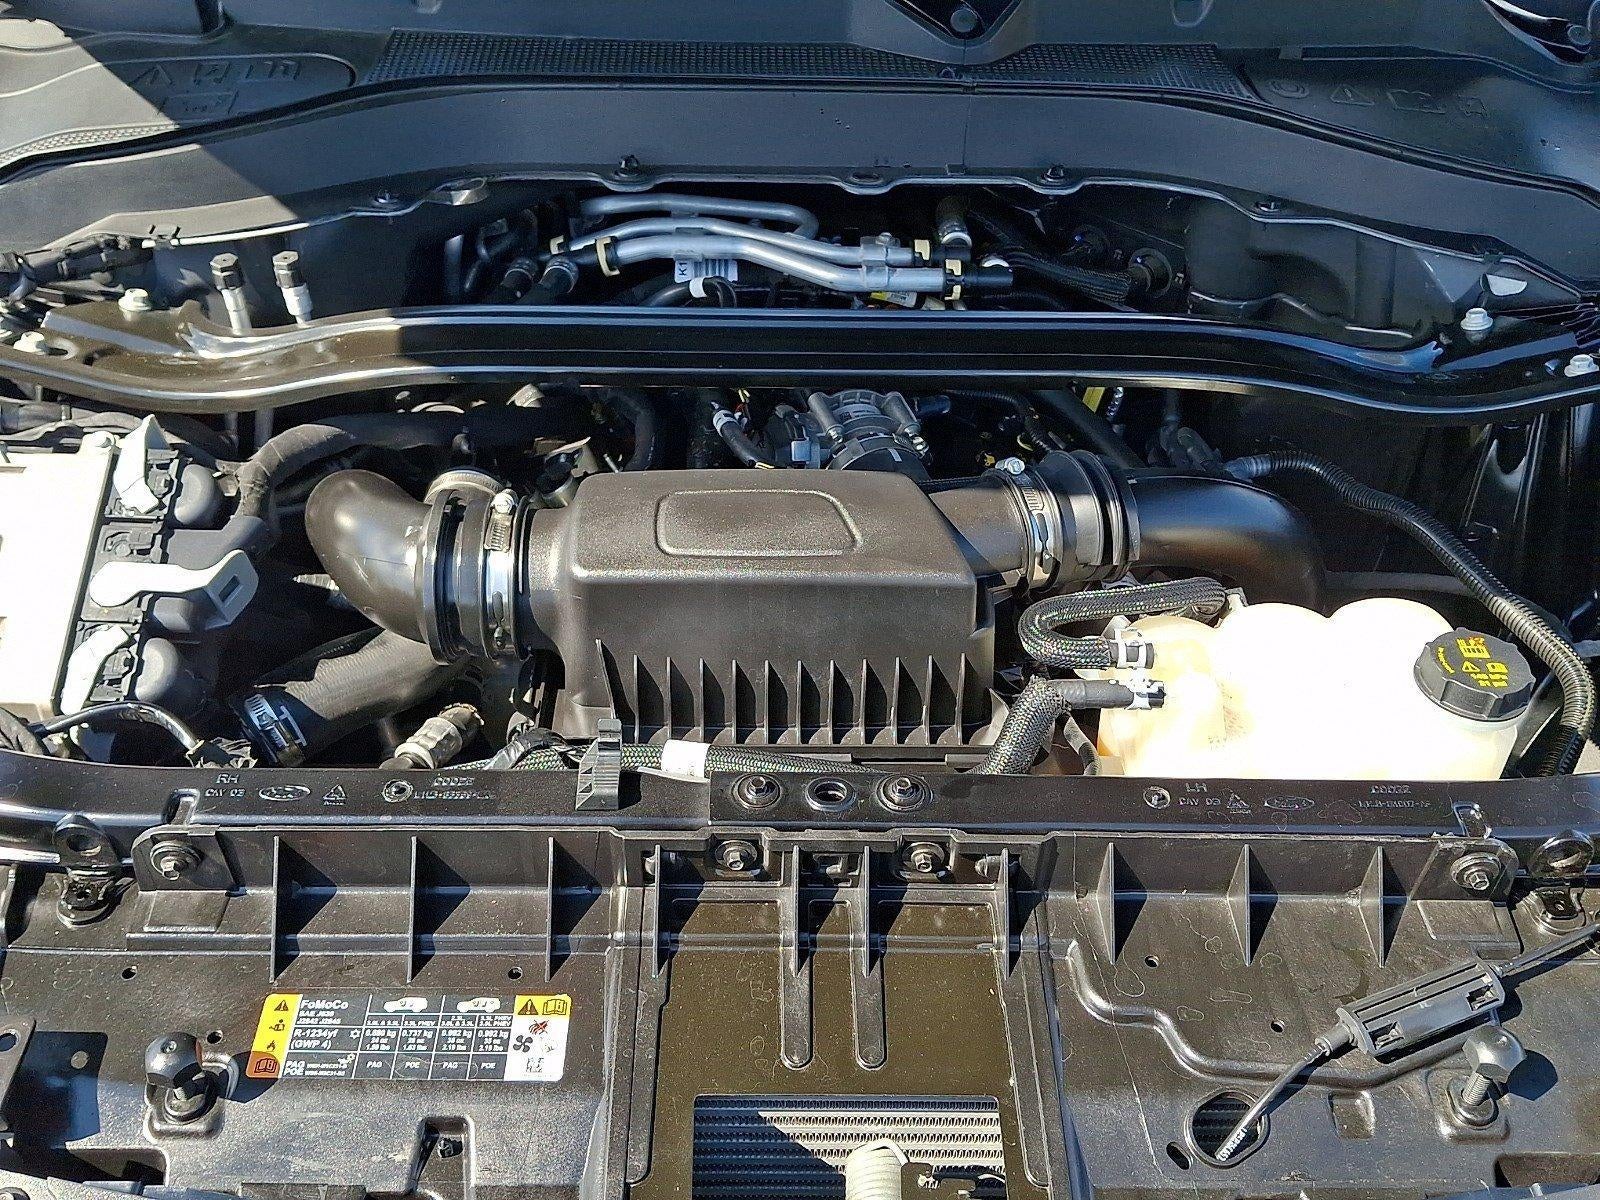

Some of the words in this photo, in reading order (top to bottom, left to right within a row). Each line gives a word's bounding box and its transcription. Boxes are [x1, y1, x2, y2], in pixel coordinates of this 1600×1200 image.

[216, 773, 239, 784] RH
[1185, 782, 1208, 793] LH
[300, 999, 349, 1010] FoMoCo
[293, 1028, 339, 1040] R-1234yf
[386, 1029, 397, 1039] kg
[423, 1029, 433, 1039] kg
[462, 1029, 473, 1039] kg
[498, 1029, 509, 1040] kg
[290, 1039, 321, 1050] (GWP
[321, 1040, 332, 1050] 4)
[286, 1060, 306, 1069] PAG
[366, 1060, 383, 1069] PAG
[405, 1061, 421, 1069] POE
[442, 1061, 458, 1069] PAG
[283, 1068, 305, 1076] POE
